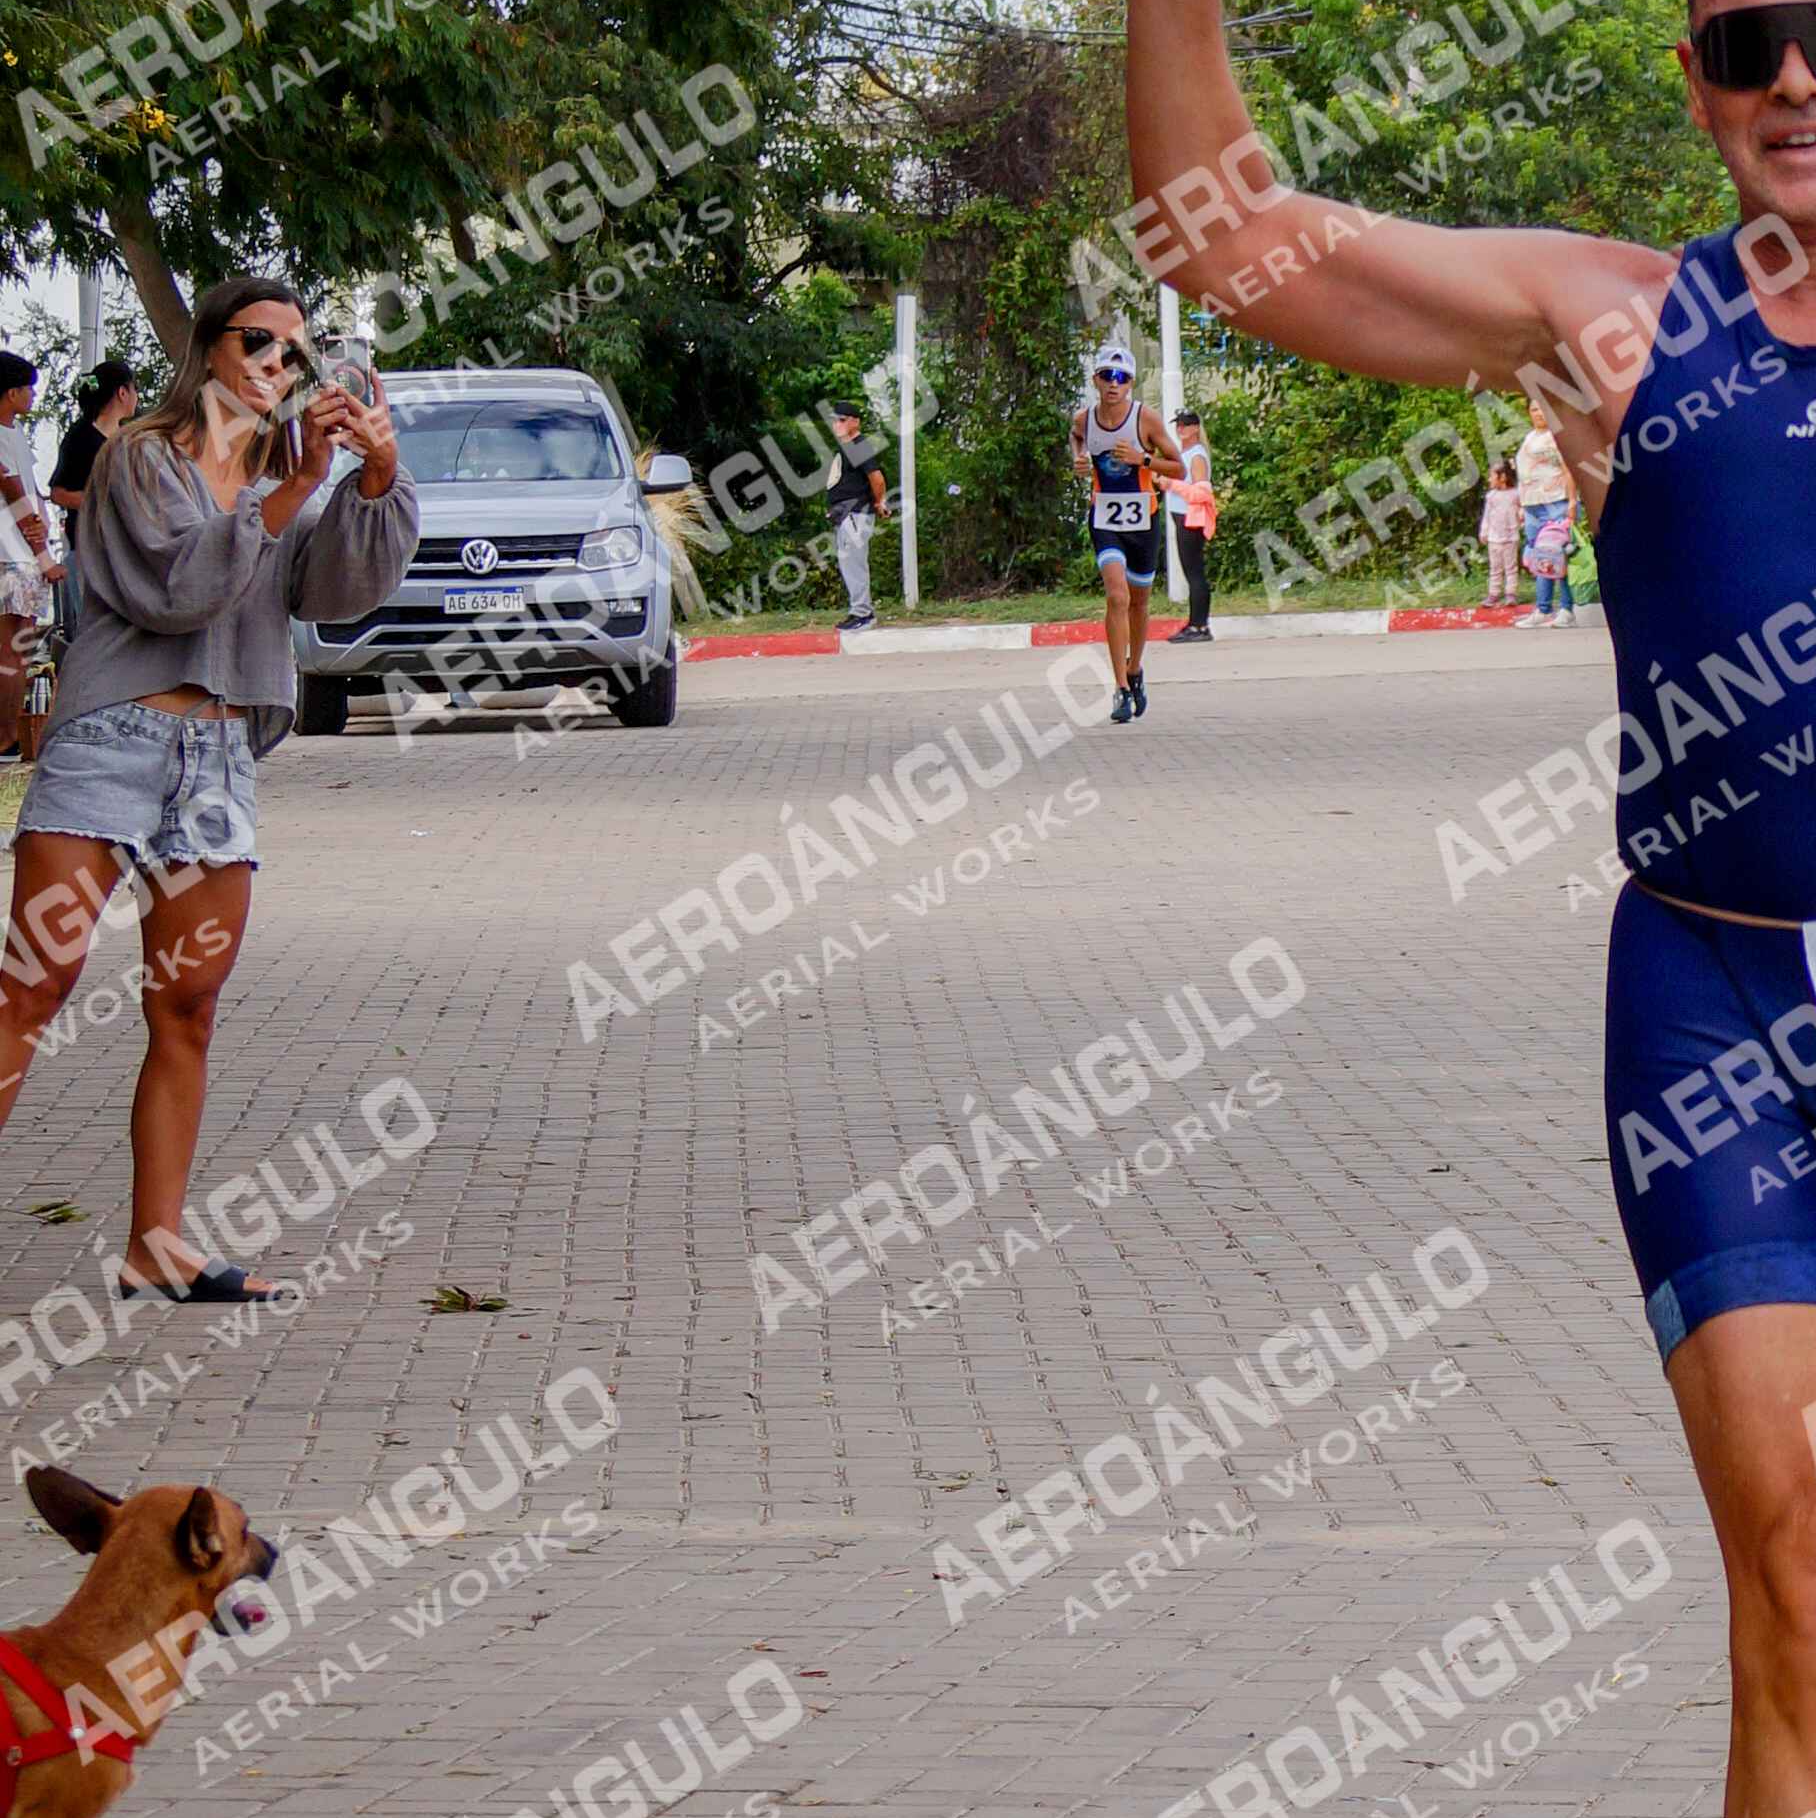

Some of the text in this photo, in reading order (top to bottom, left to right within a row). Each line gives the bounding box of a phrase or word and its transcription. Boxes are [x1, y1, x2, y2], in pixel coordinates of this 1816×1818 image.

[1106, 501, 1143, 525] 23
[448, 596, 467, 611] AG
[471, 595, 498, 611] 634
